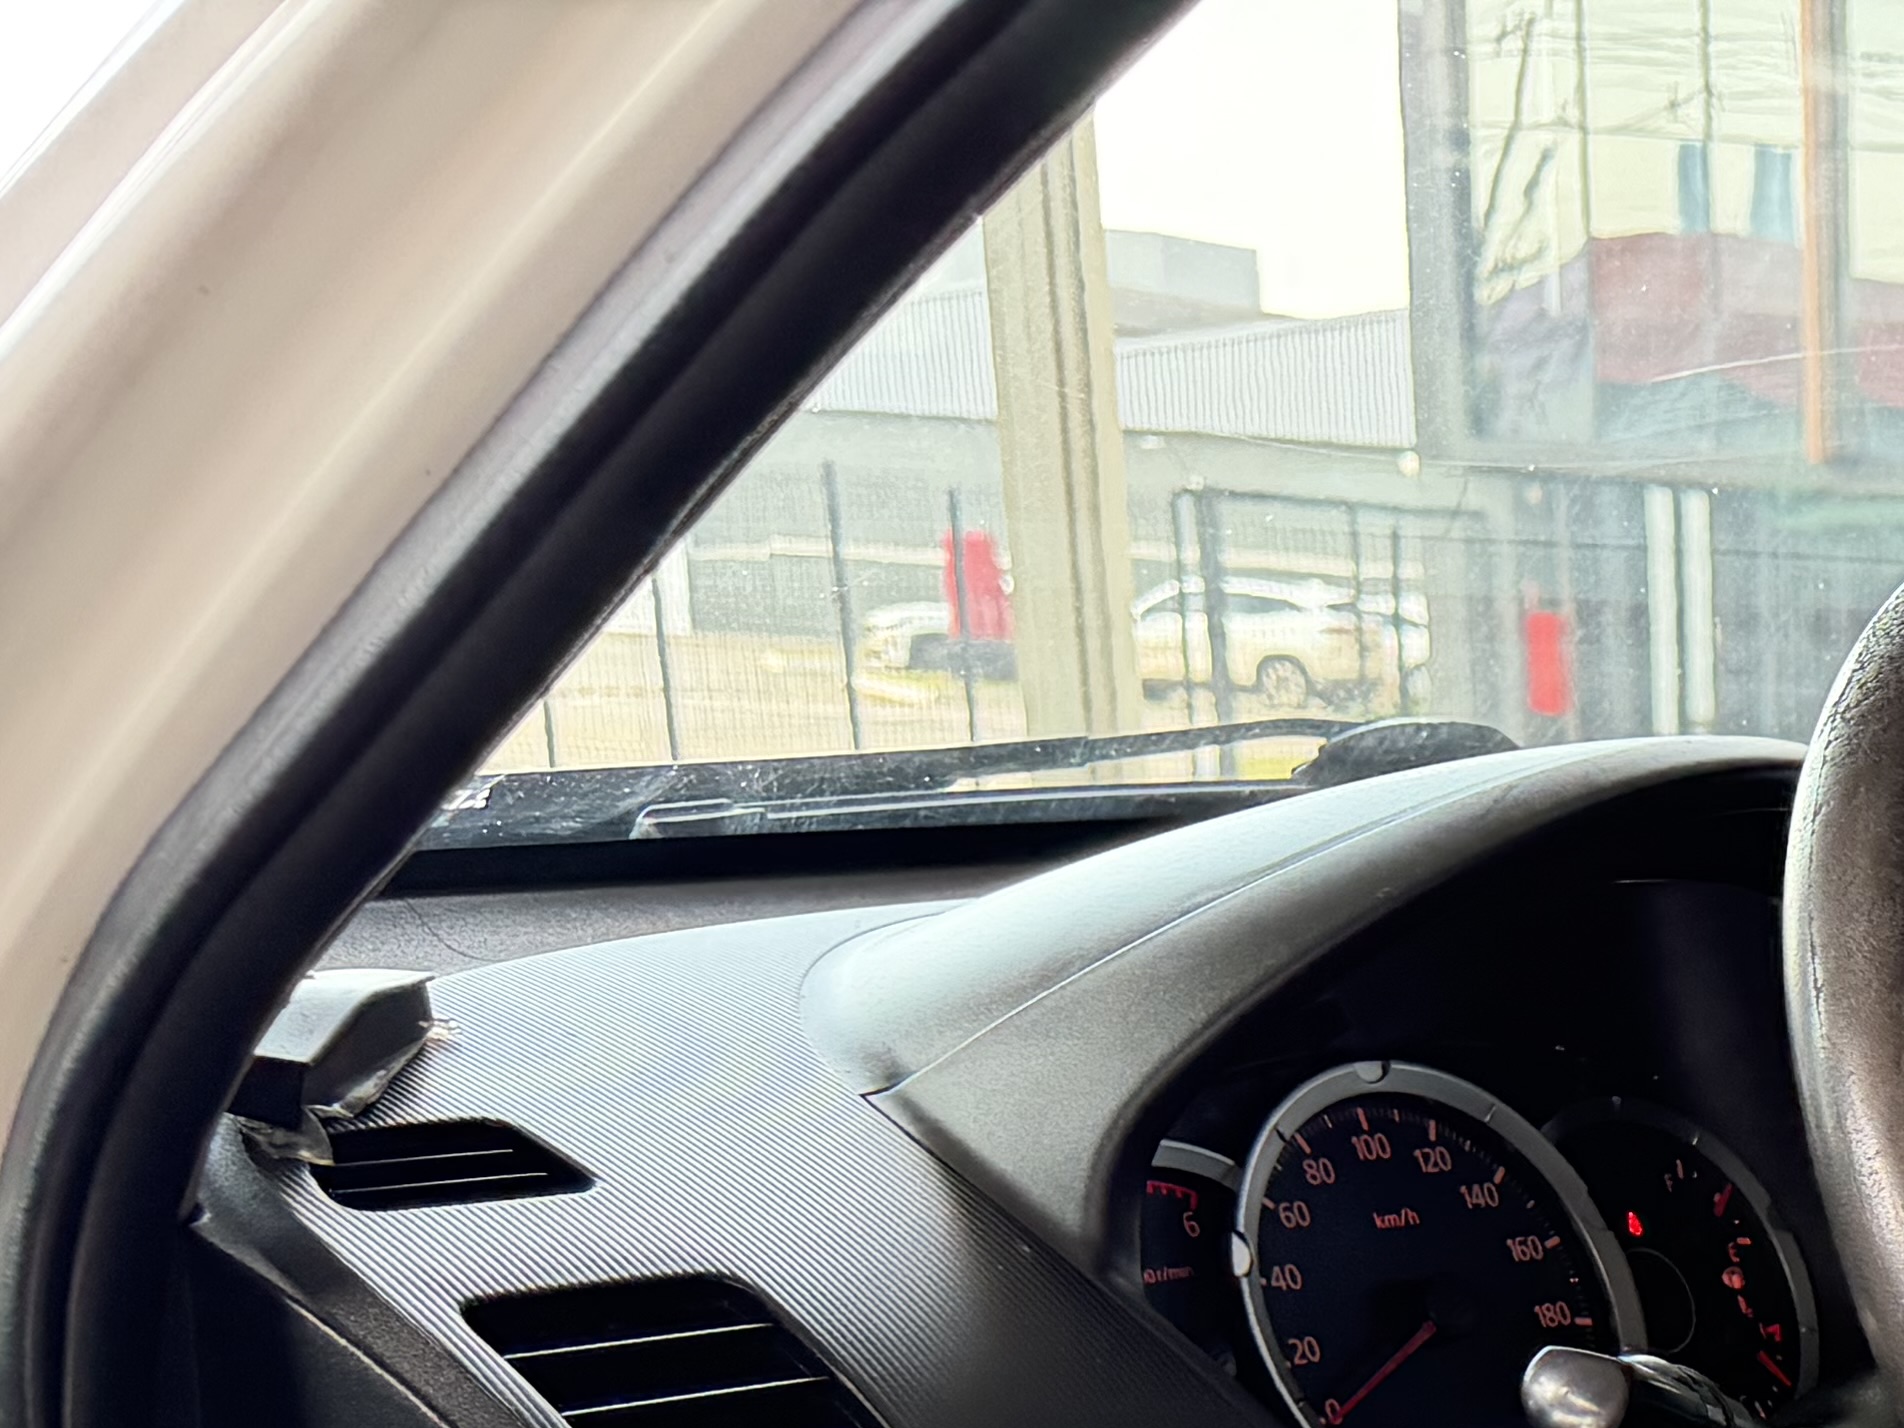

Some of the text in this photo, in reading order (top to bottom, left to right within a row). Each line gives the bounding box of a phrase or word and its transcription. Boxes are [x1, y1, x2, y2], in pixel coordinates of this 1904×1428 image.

[1351, 1133, 1392, 1162] 100
[1414, 1145, 1453, 1174] 120
[1304, 1158, 1335, 1186] 80
[1460, 1182, 1500, 1210] 140
[1183, 1211, 1201, 1238] 6
[1279, 1202, 1310, 1229] 60
[1373, 1208, 1420, 1230] km/h
[1506, 1236, 1544, 1262] 160
[1270, 1263, 1303, 1291] 40
[1534, 1302, 1572, 1328] 180
[1290, 1336, 1320, 1364] 20
[1325, 1399, 1341, 1425] 0
